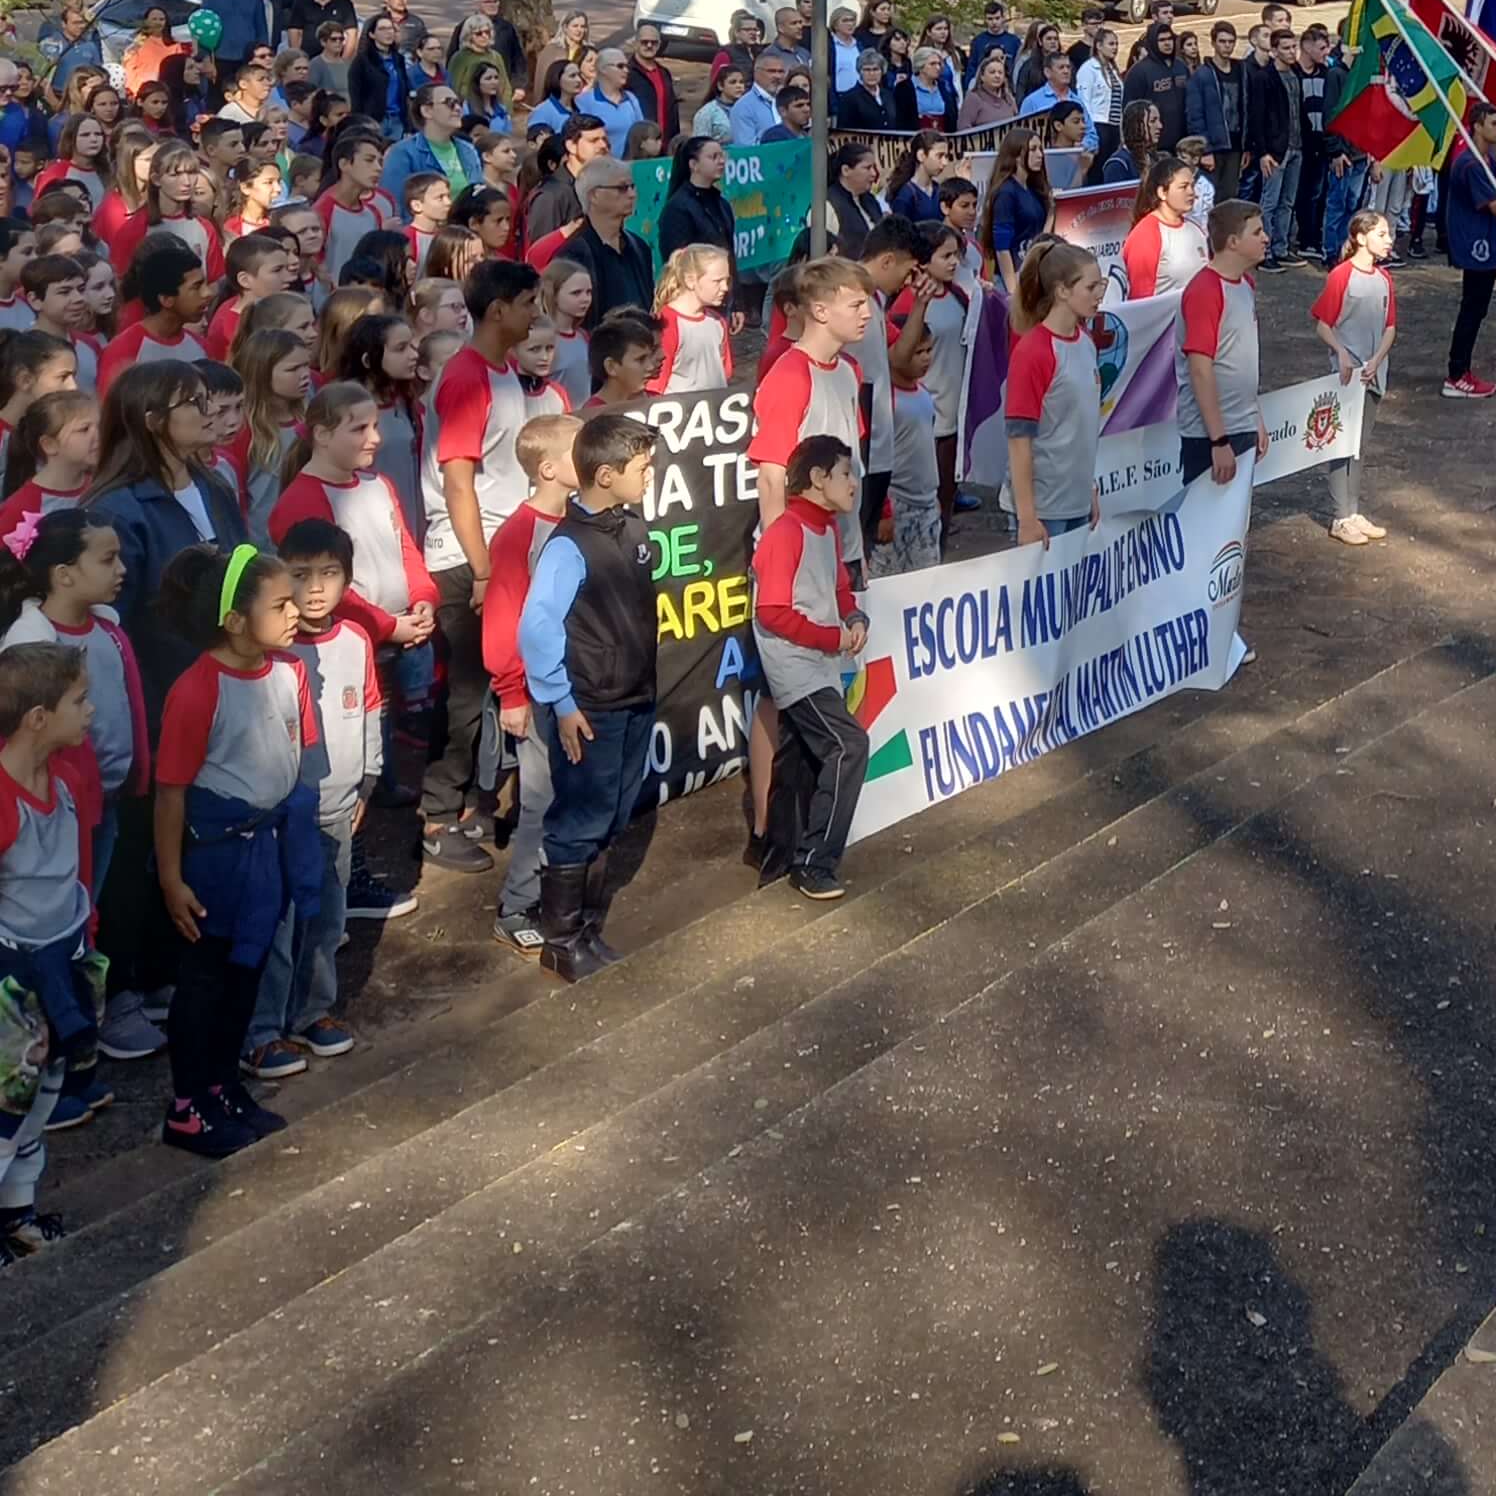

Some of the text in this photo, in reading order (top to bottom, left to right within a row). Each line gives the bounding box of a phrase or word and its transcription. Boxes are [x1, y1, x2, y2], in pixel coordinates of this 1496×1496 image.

[725, 156, 764, 185] POR
[1143, 458, 1171, 482] São
[903, 584, 1014, 681] ESCOLA
[1113, 534, 1126, 606] DE
[1127, 512, 1185, 594] ENSINO
[1077, 640, 1141, 732] MARTIN
[1134, 608, 1209, 697] LUTHER
